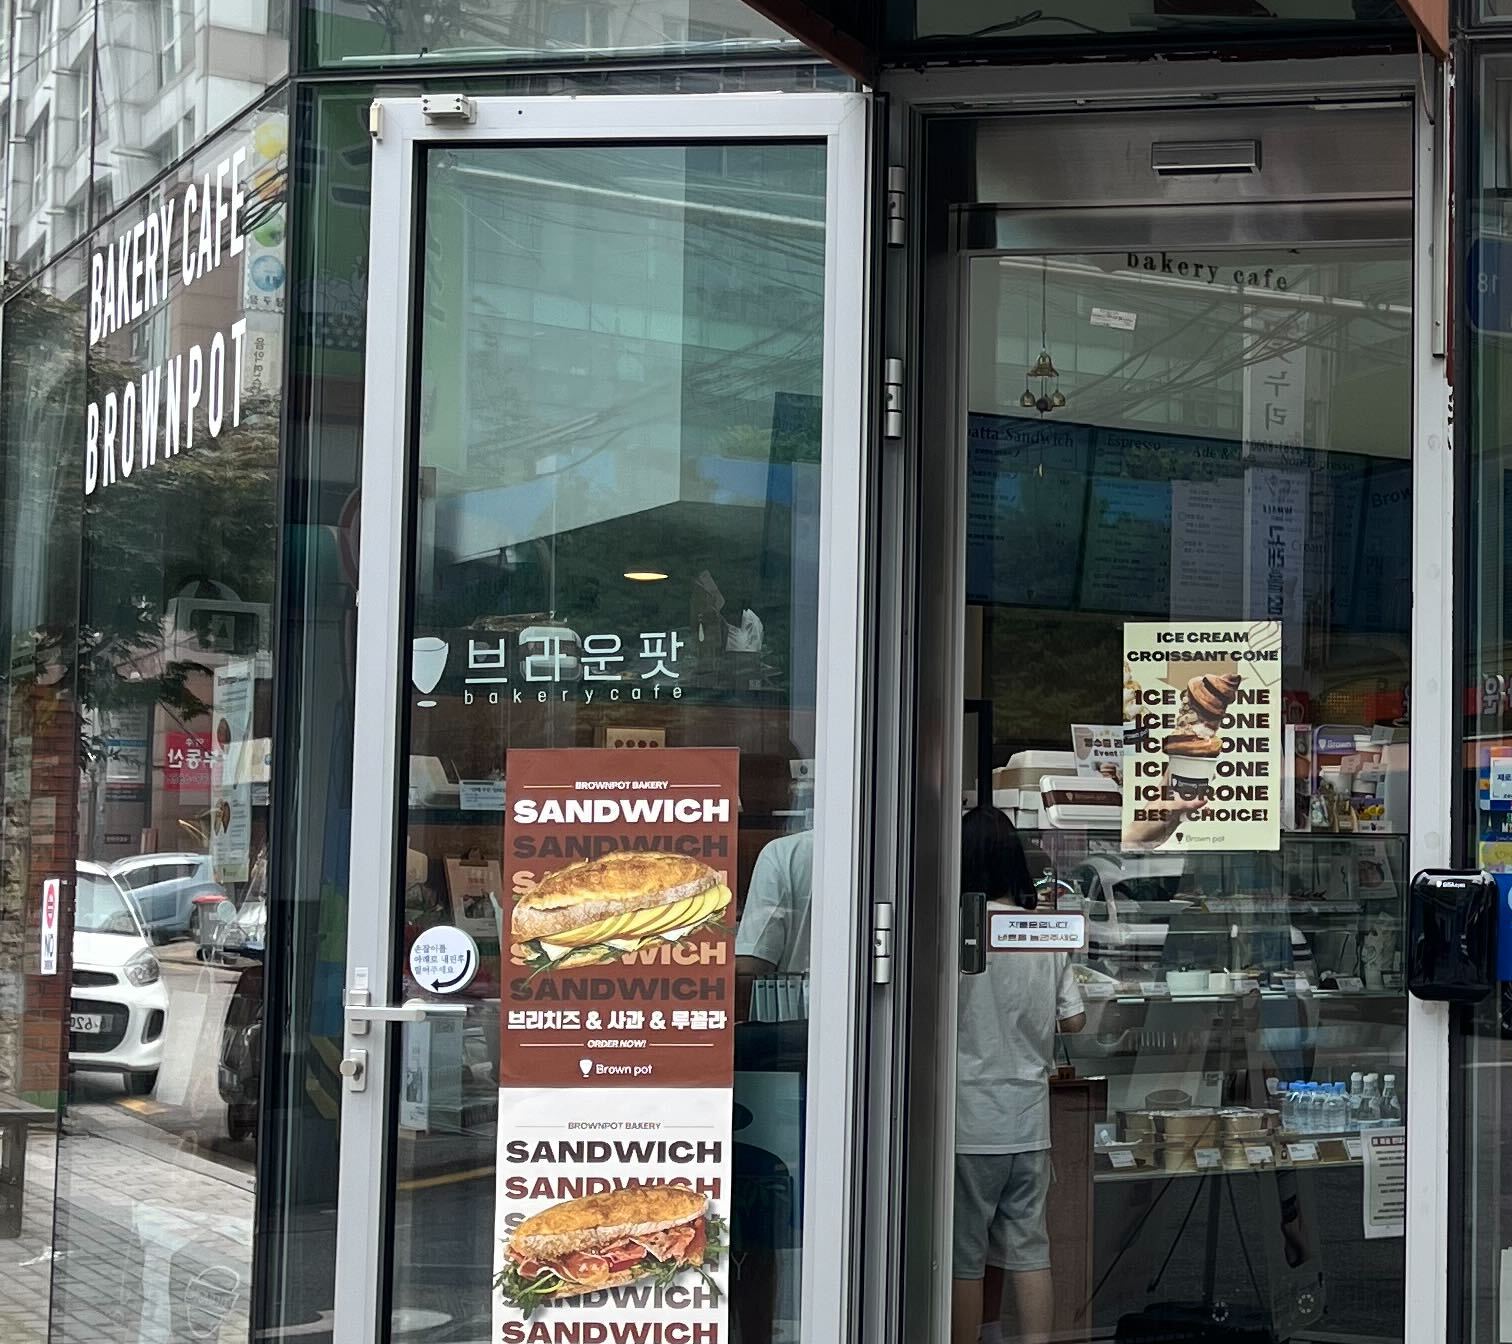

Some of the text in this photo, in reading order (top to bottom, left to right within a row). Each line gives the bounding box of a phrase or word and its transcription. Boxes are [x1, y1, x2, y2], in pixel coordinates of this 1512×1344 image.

[90, 146, 246, 347] BAKERY CAFE
[1127, 253, 1289, 291] bakery cafe
[85, 318, 247, 495] BROWNPOT
[1107, 435, 1161, 454] Espresso
[1156, 632, 1250, 644] ICE CREAM
[465, 631, 684, 684] 브라운팟
[1127, 649, 1279, 662] CROISSANT CONE
[1135, 690, 1176, 705] ICE
[575, 780, 668, 790] BROWNPOT BAKERY
[1134, 786, 1176, 801] ICE
[513, 798, 729, 824] SANDWICH
[1186, 808, 1268, 822] CHOICE!
[510, 977, 725, 1001] SANDWICH
[508, 1009, 727, 1031] 브리치즈 & 사과 & 루꼴라
[587, 1039, 647, 1049] ORDER NOW!
[596, 1063, 653, 1078] Brown pot
[568, 1122, 661, 1131] BROWNPOT BAKERY
[506, 1140, 722, 1164] SANDWICH
[502, 1321, 718, 1344] SANDWICH
